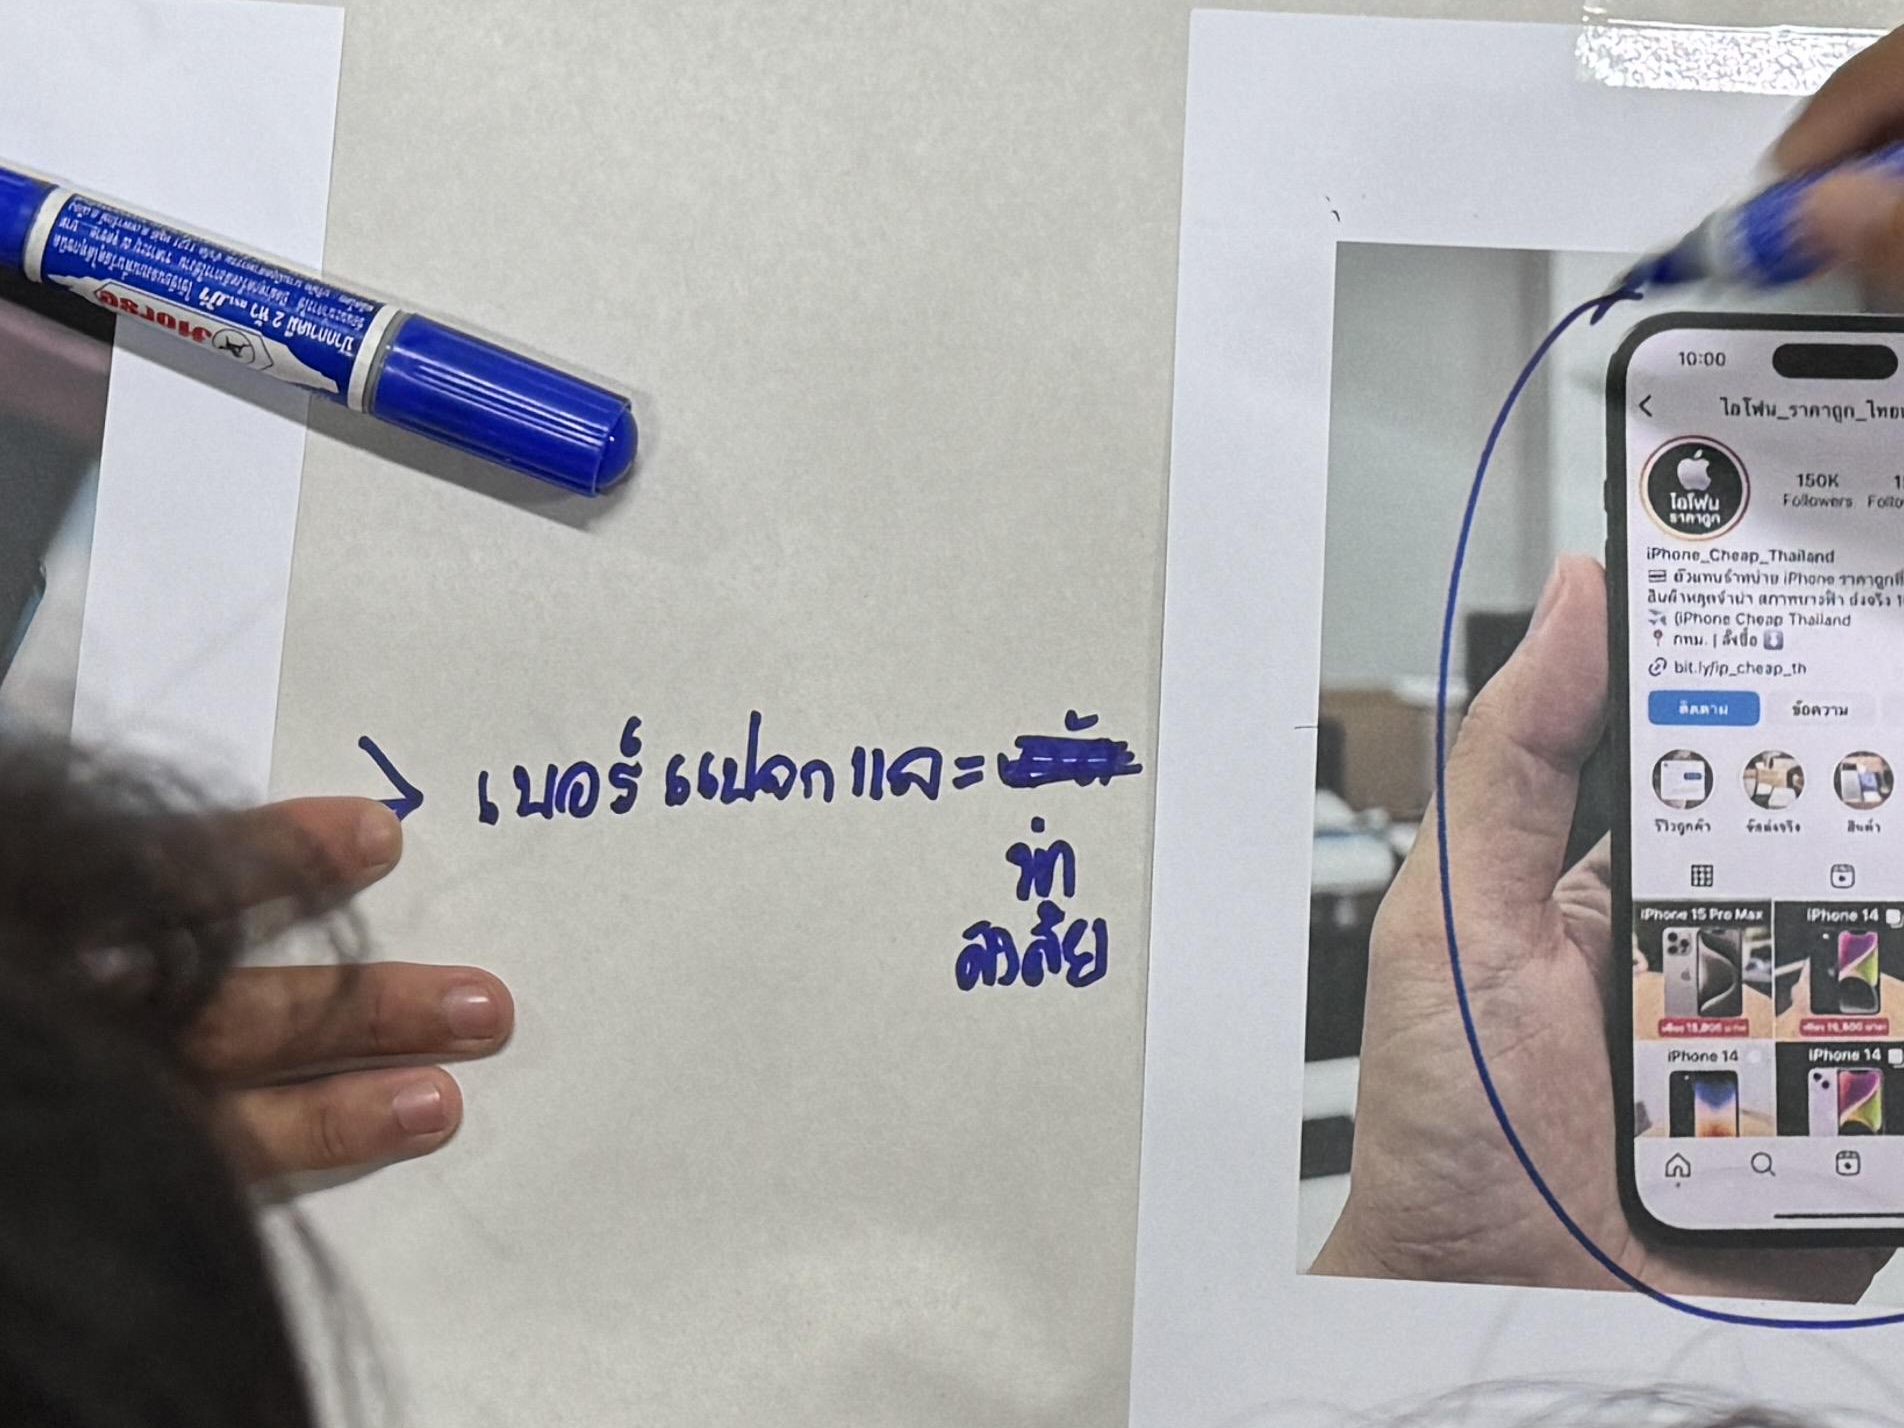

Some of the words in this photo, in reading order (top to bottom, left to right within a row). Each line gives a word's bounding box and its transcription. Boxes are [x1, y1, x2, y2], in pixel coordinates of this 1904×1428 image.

[271, 309, 285, 329] 2
[1677, 351, 1727, 367] 10:00
[1797, 473, 1839, 489] 150K
[1670, 492, 1719, 510] ไอโฟน
[1783, 494, 1853, 509] Followers
[1669, 511, 1722, 527] ราคาถูก
[1646, 547, 1836, 565] iPhone_Cheap_Thailand
[1783, 572, 1836, 586] iPhone
[1736, 613, 1784, 629] Cheap
[1788, 613, 1852, 627] Thailand
[1792, 701, 1849, 718] ข้อความ
[1640, 908, 1688, 922] iPhone
[1735, 909, 1763, 921] Max
[1807, 908, 1857, 922] iPhone
[1861, 908, 1879, 922] 14
[1667, 1048, 1717, 1063] iPhone
[1721, 1049, 1739, 1062] 14
[1809, 1048, 1859, 1063] iPhone
[1863, 1048, 1882, 1062] 14
